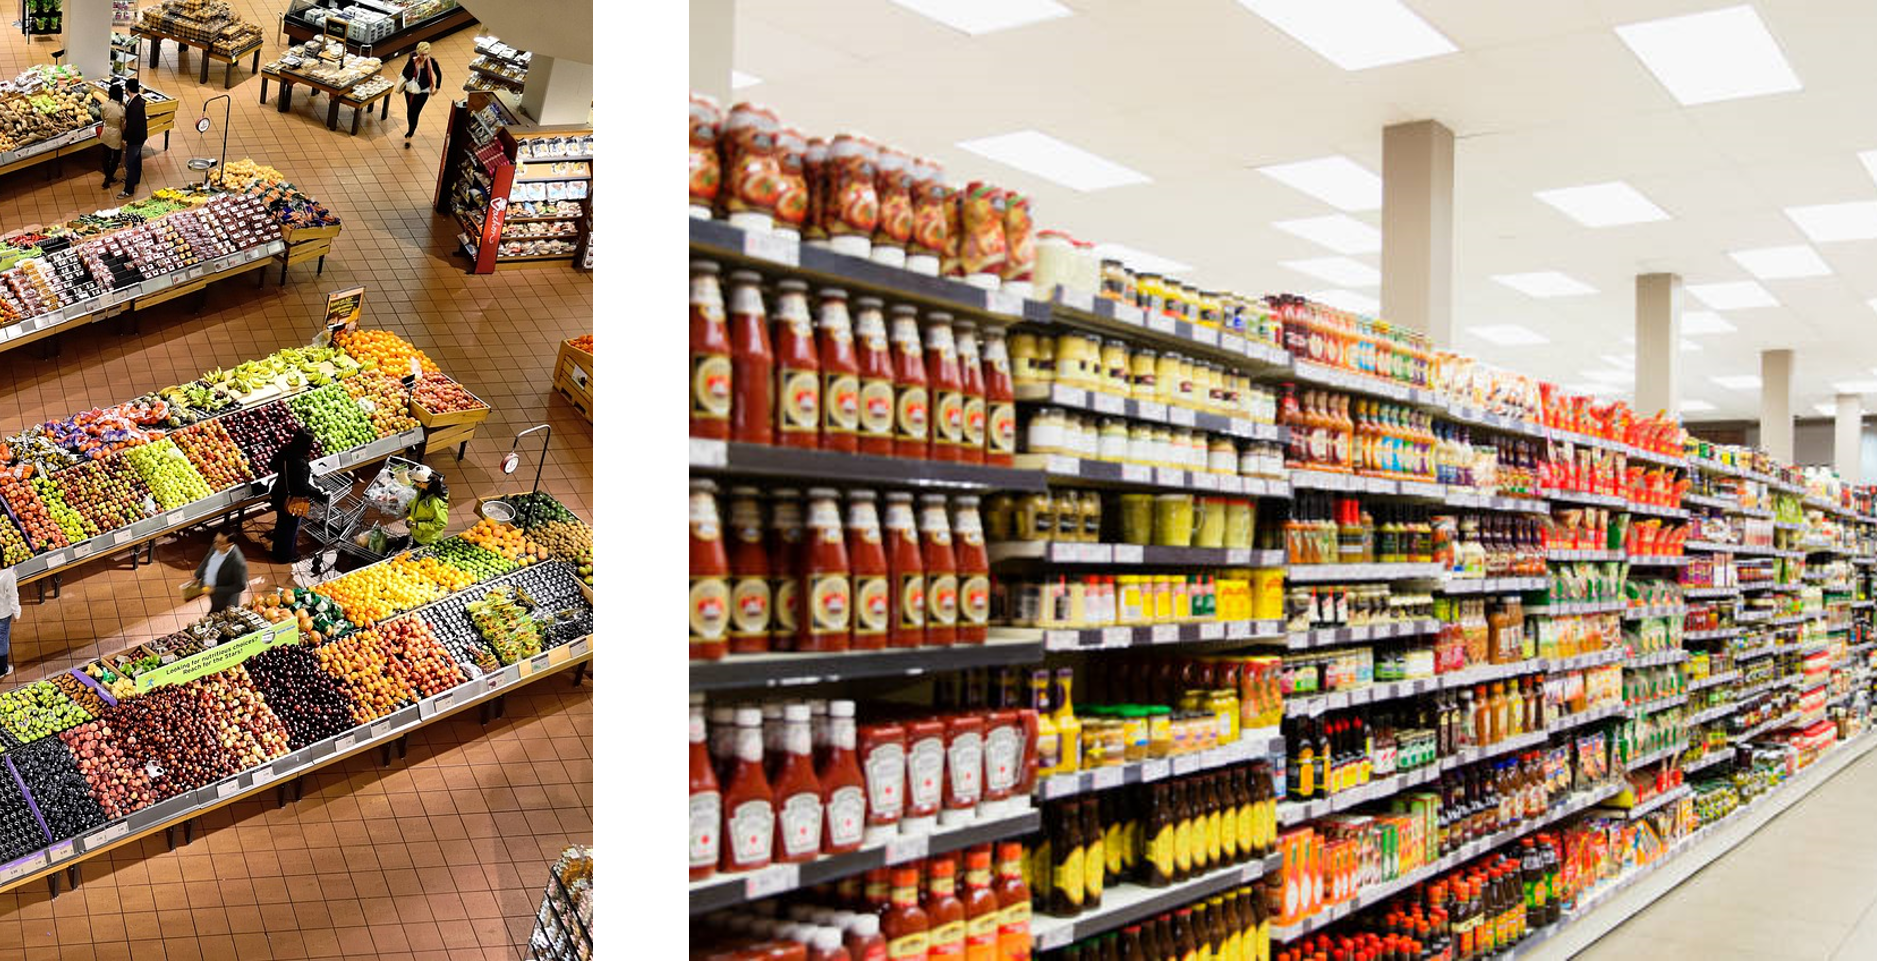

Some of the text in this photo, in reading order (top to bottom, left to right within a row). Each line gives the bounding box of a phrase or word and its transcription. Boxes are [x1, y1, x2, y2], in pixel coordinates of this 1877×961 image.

[490, 197, 503, 244] Vachon
[166, 636, 258, 675] Looking for nutritious choices?
[182, 663, 202, 674] Reach
[212, 655, 223, 664] the
[224, 648, 243, 660] Stars!
